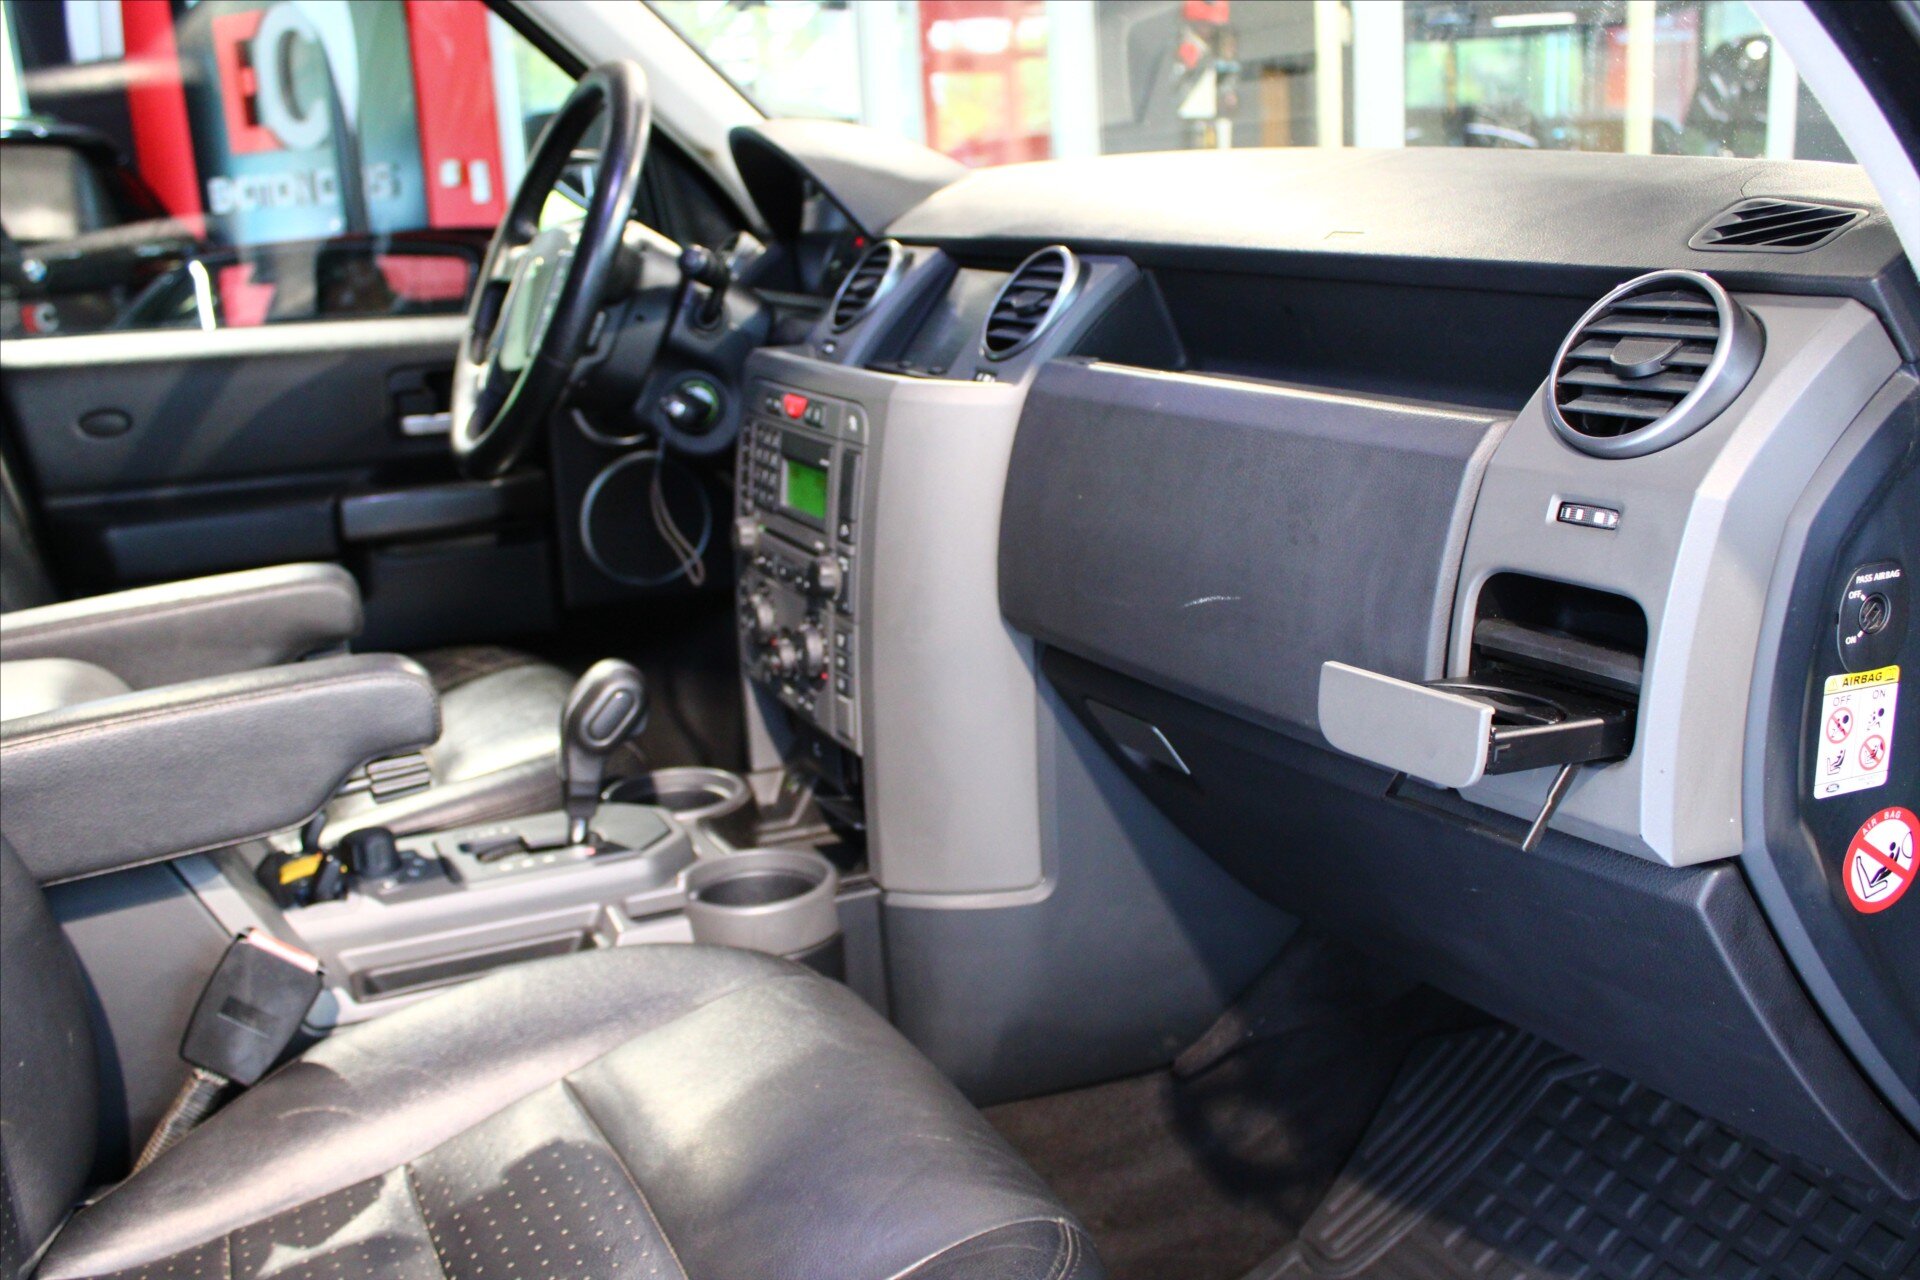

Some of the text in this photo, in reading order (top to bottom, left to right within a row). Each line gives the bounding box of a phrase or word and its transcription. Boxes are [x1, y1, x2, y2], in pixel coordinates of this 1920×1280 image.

[1856, 569, 1901, 584] PASS AIRBAG
[1848, 589, 1862, 599] OFF
[1845, 635, 1857, 645] ON
[1842, 671, 1882, 687] AIRBAG
[1833, 694, 1852, 706] OFF
[1872, 689, 1886, 700] ON
[1862, 810, 1902, 836] AIR BAG
